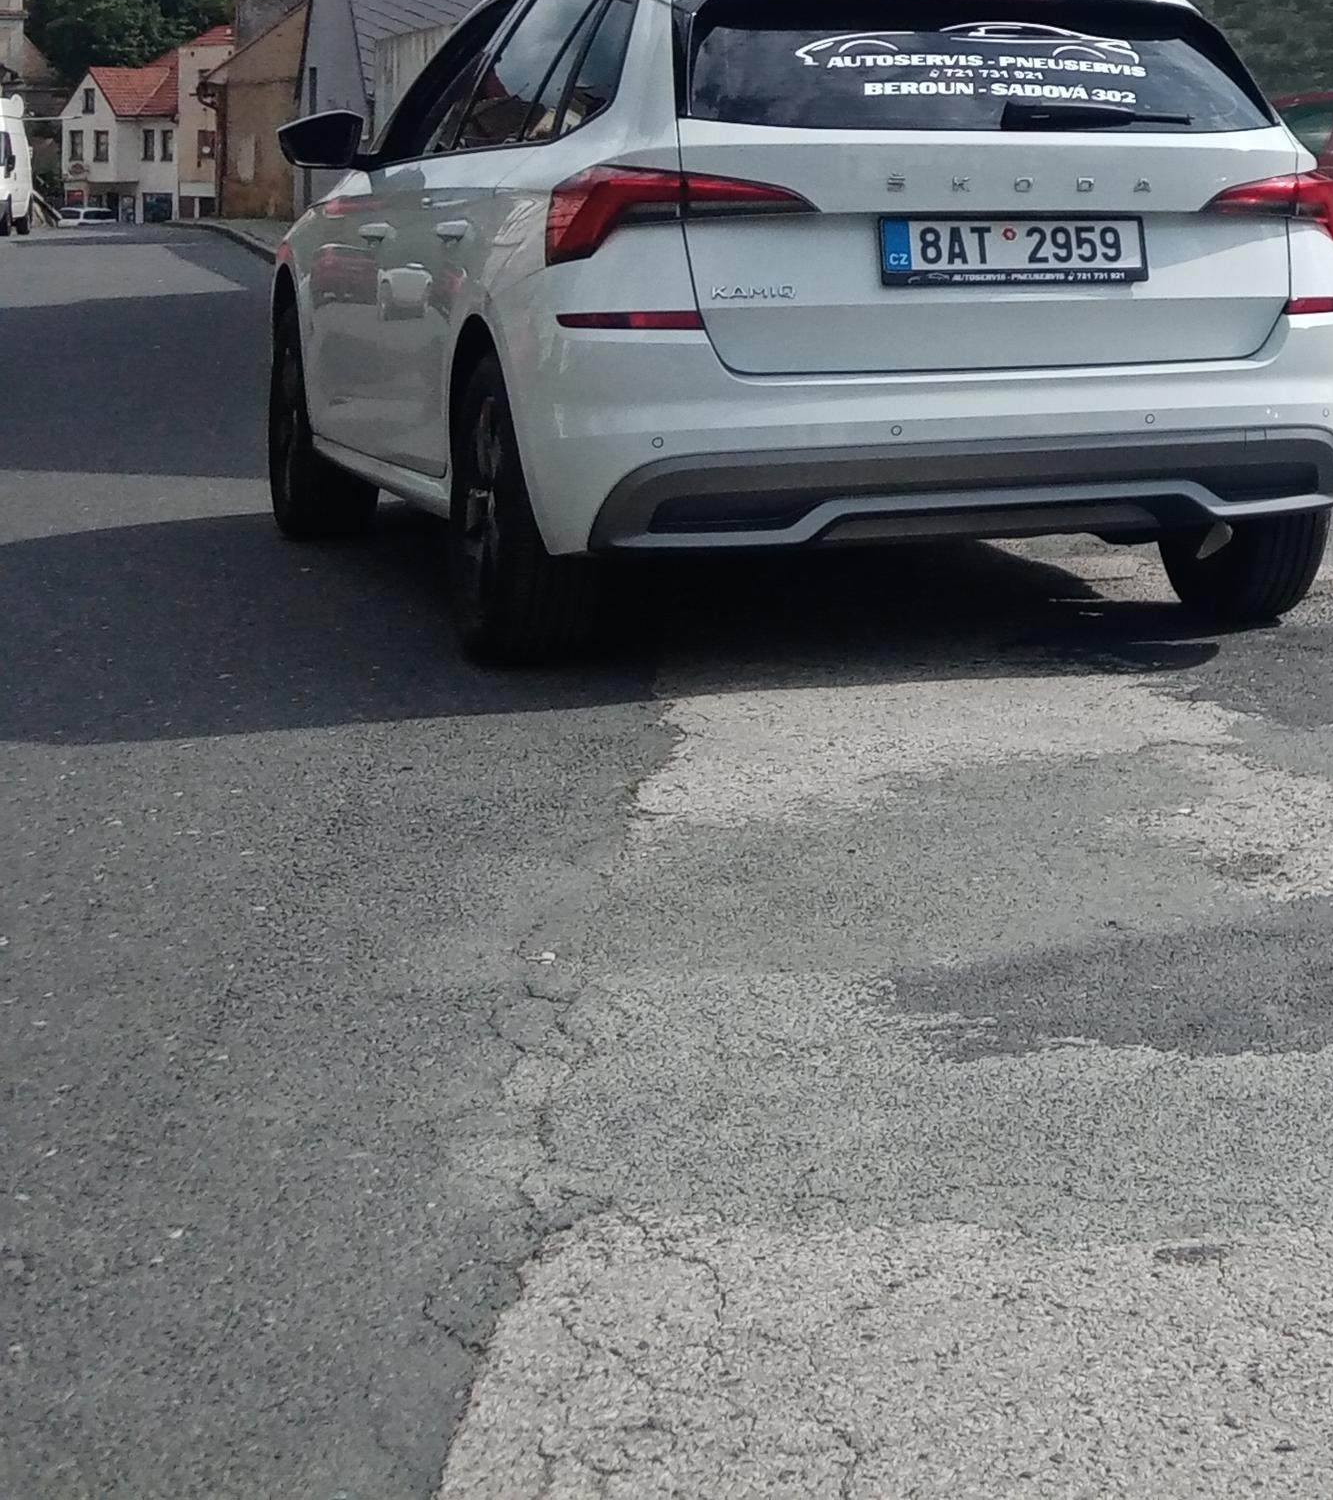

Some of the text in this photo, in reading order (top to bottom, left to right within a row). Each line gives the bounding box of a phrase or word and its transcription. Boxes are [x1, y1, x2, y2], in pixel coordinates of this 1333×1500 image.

[827, 55, 983, 68] AUTOSERVIS
[998, 56, 1146, 77] PNEUSERVIS
[944, 69, 1043, 80] 721 731 921
[864, 82, 973, 96] BEROUN
[991, 83, 1090, 100] SADOVÁ
[1092, 89, 1136, 103] 302
[887, 173, 1151, 192] ŠKODA
[919, 226, 1122, 265] 8AT 2959
[889, 253, 909, 265] CZ
[711, 284, 797, 300] KAMIQ
